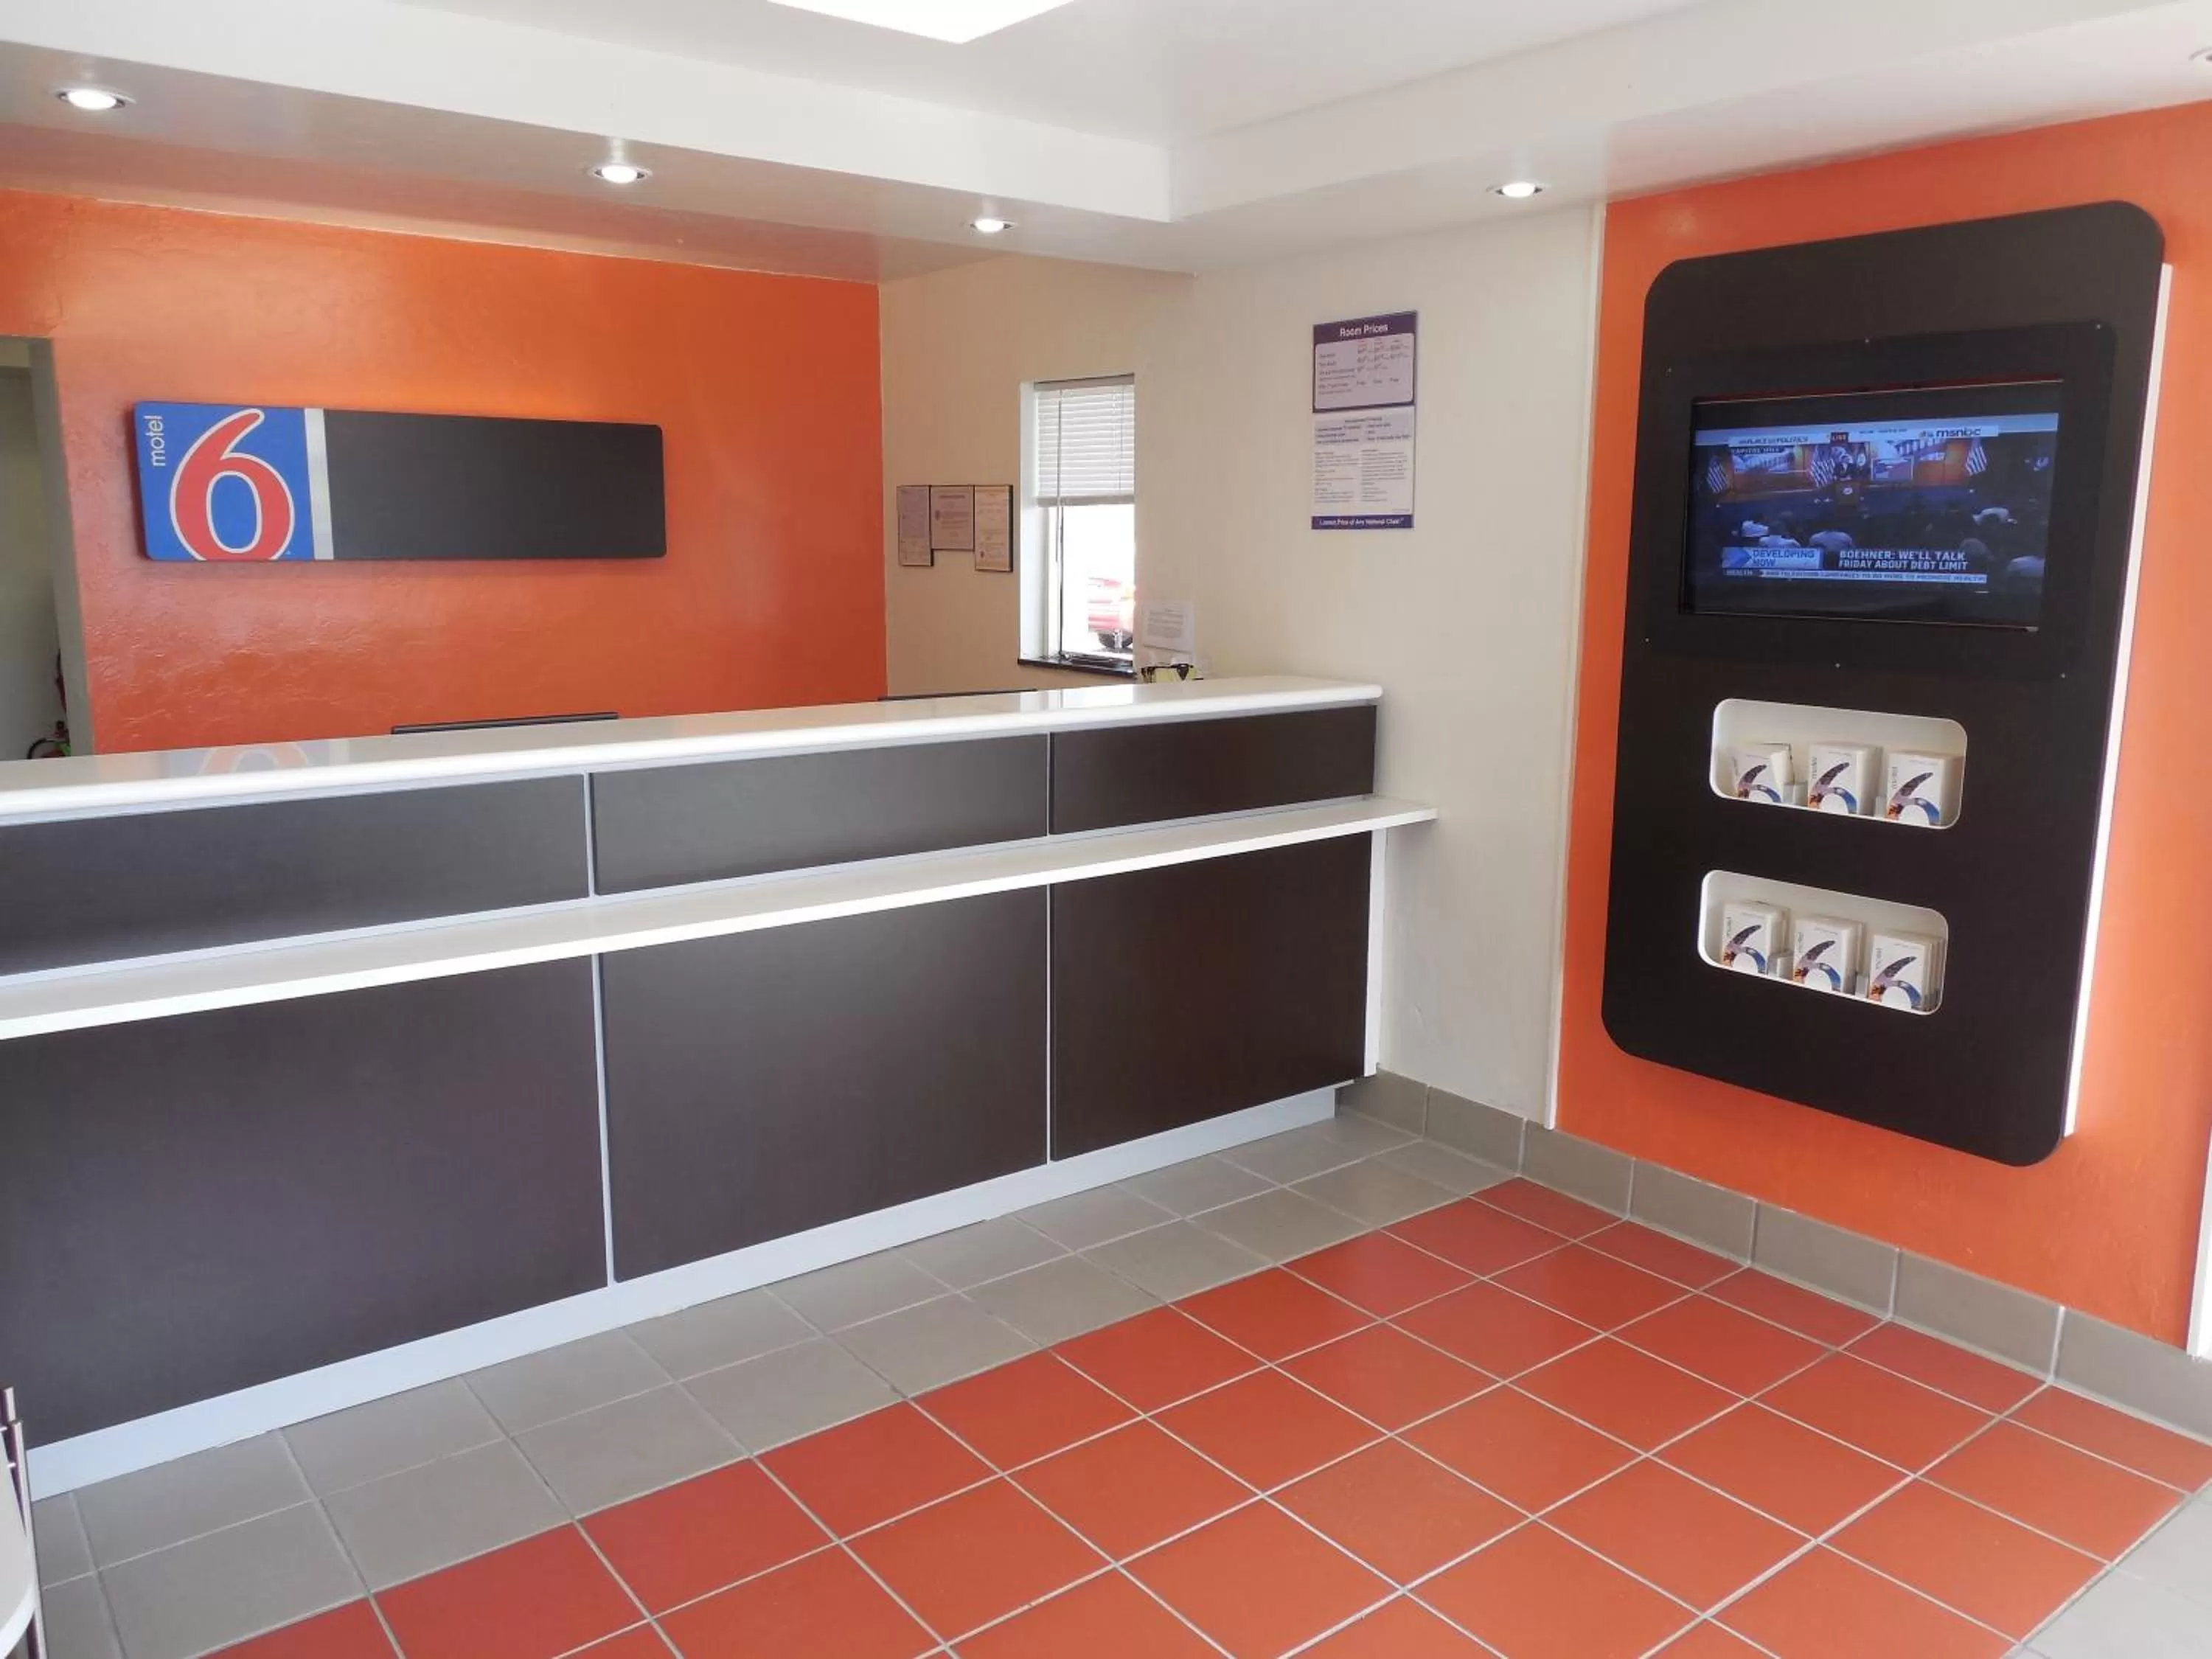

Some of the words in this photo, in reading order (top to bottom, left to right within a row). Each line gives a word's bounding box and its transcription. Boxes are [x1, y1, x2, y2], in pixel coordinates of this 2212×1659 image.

[1340, 327, 1362, 337] Room
[1363, 323, 1388, 334] Prices
[1935, 427, 1982, 437] msnbc
[143, 414, 166, 467] motel
[169, 408, 295, 561] 6
[1752, 549, 1815, 558] DEVELOPING
[1840, 550, 1895, 560] BOEHNER:
[1899, 551, 1931, 560] WE'LL
[1935, 552, 1966, 561] TALK
[1752, 558, 1776, 567] NOW
[1838, 560, 1874, 568] FRIDAY
[1874, 560, 1909, 569] ABOUT
[1910, 560, 1935, 570] DEBT
[1938, 561, 1969, 571] LIMIT
